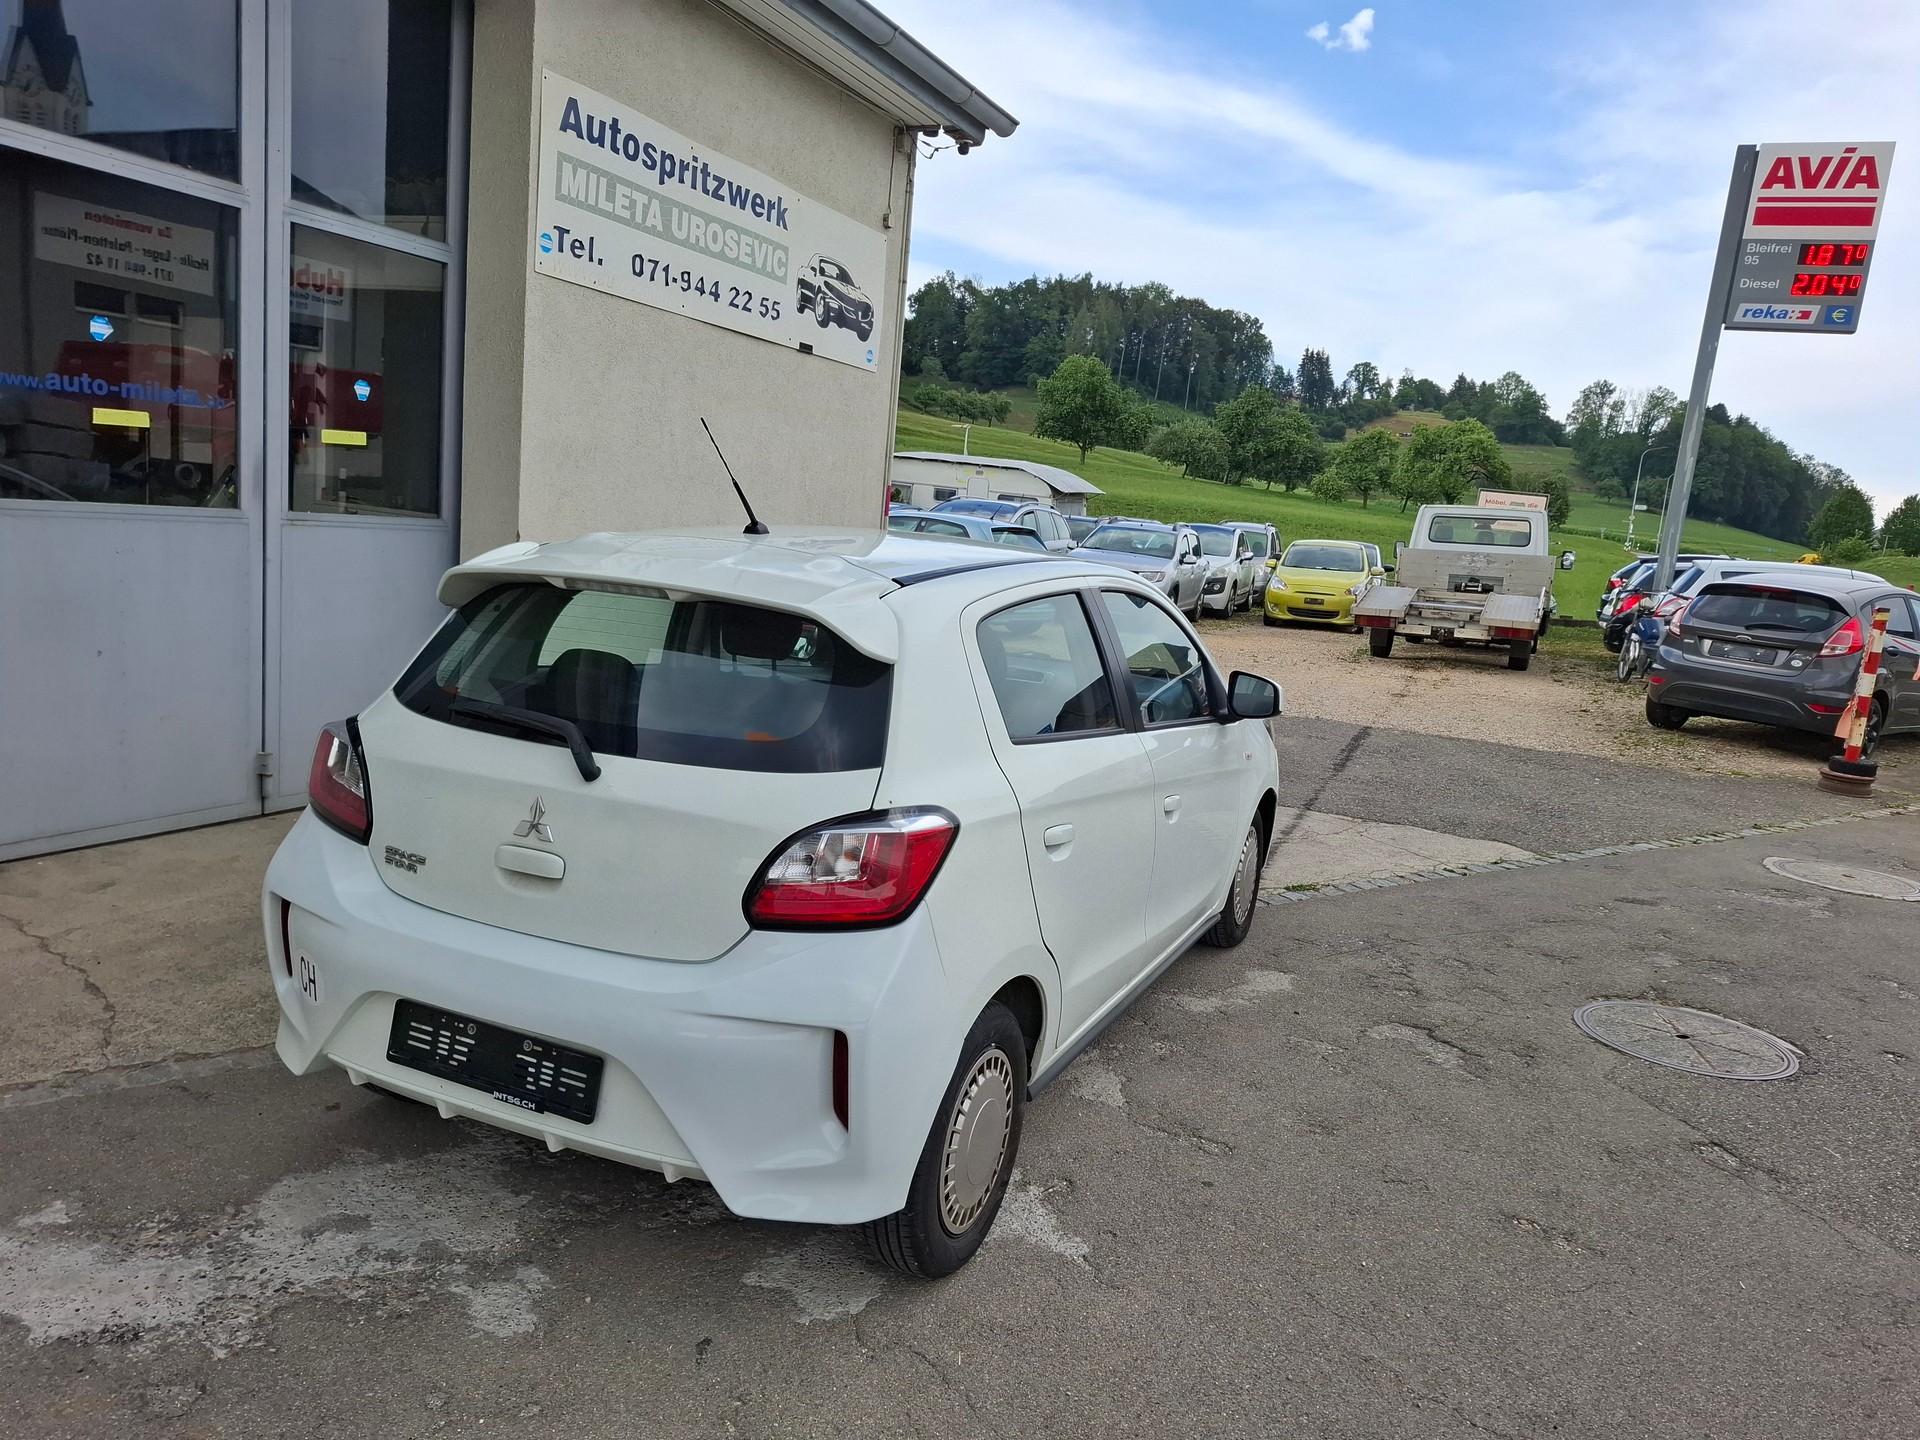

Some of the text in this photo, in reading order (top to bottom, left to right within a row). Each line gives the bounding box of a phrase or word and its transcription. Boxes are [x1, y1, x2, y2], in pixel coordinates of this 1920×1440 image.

[558, 95, 790, 232] Autospritzwerk
[560, 160, 664, 233] MILETA
[671, 206, 787, 278] UROSEVIC
[1746, 243, 1792, 253] Bleifrei
[1744, 256, 1760, 265] 95
[553, 225, 604, 266] Tel.
[631, 253, 721, 303] 071-944
[728, 286, 753, 314] 22
[759, 297, 781, 321] 55
[1740, 279, 1780, 289] Diesel
[384, 845, 427, 866] SPACE
[384, 855, 418, 875] STAR
[300, 955, 318, 1002] CH
